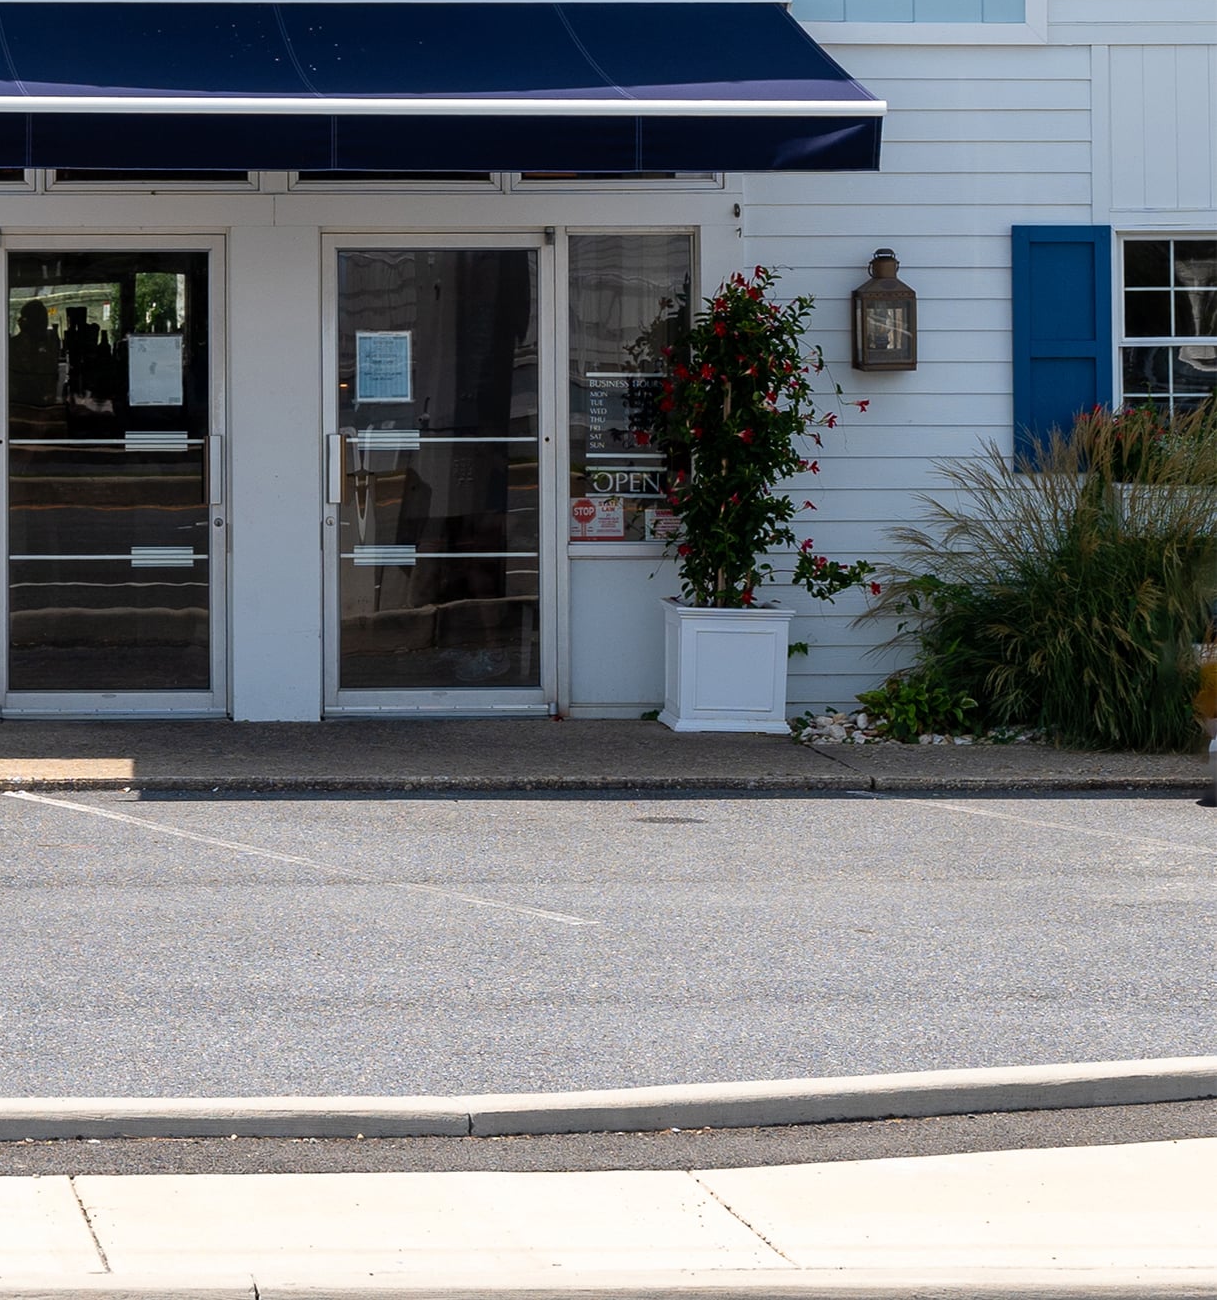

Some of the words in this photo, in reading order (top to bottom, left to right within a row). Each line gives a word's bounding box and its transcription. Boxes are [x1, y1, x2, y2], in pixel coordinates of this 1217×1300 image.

[589, 380, 629, 388] BUSINESS
[592, 472, 660, 492] OPEN
[573, 507, 595, 516] STOP
